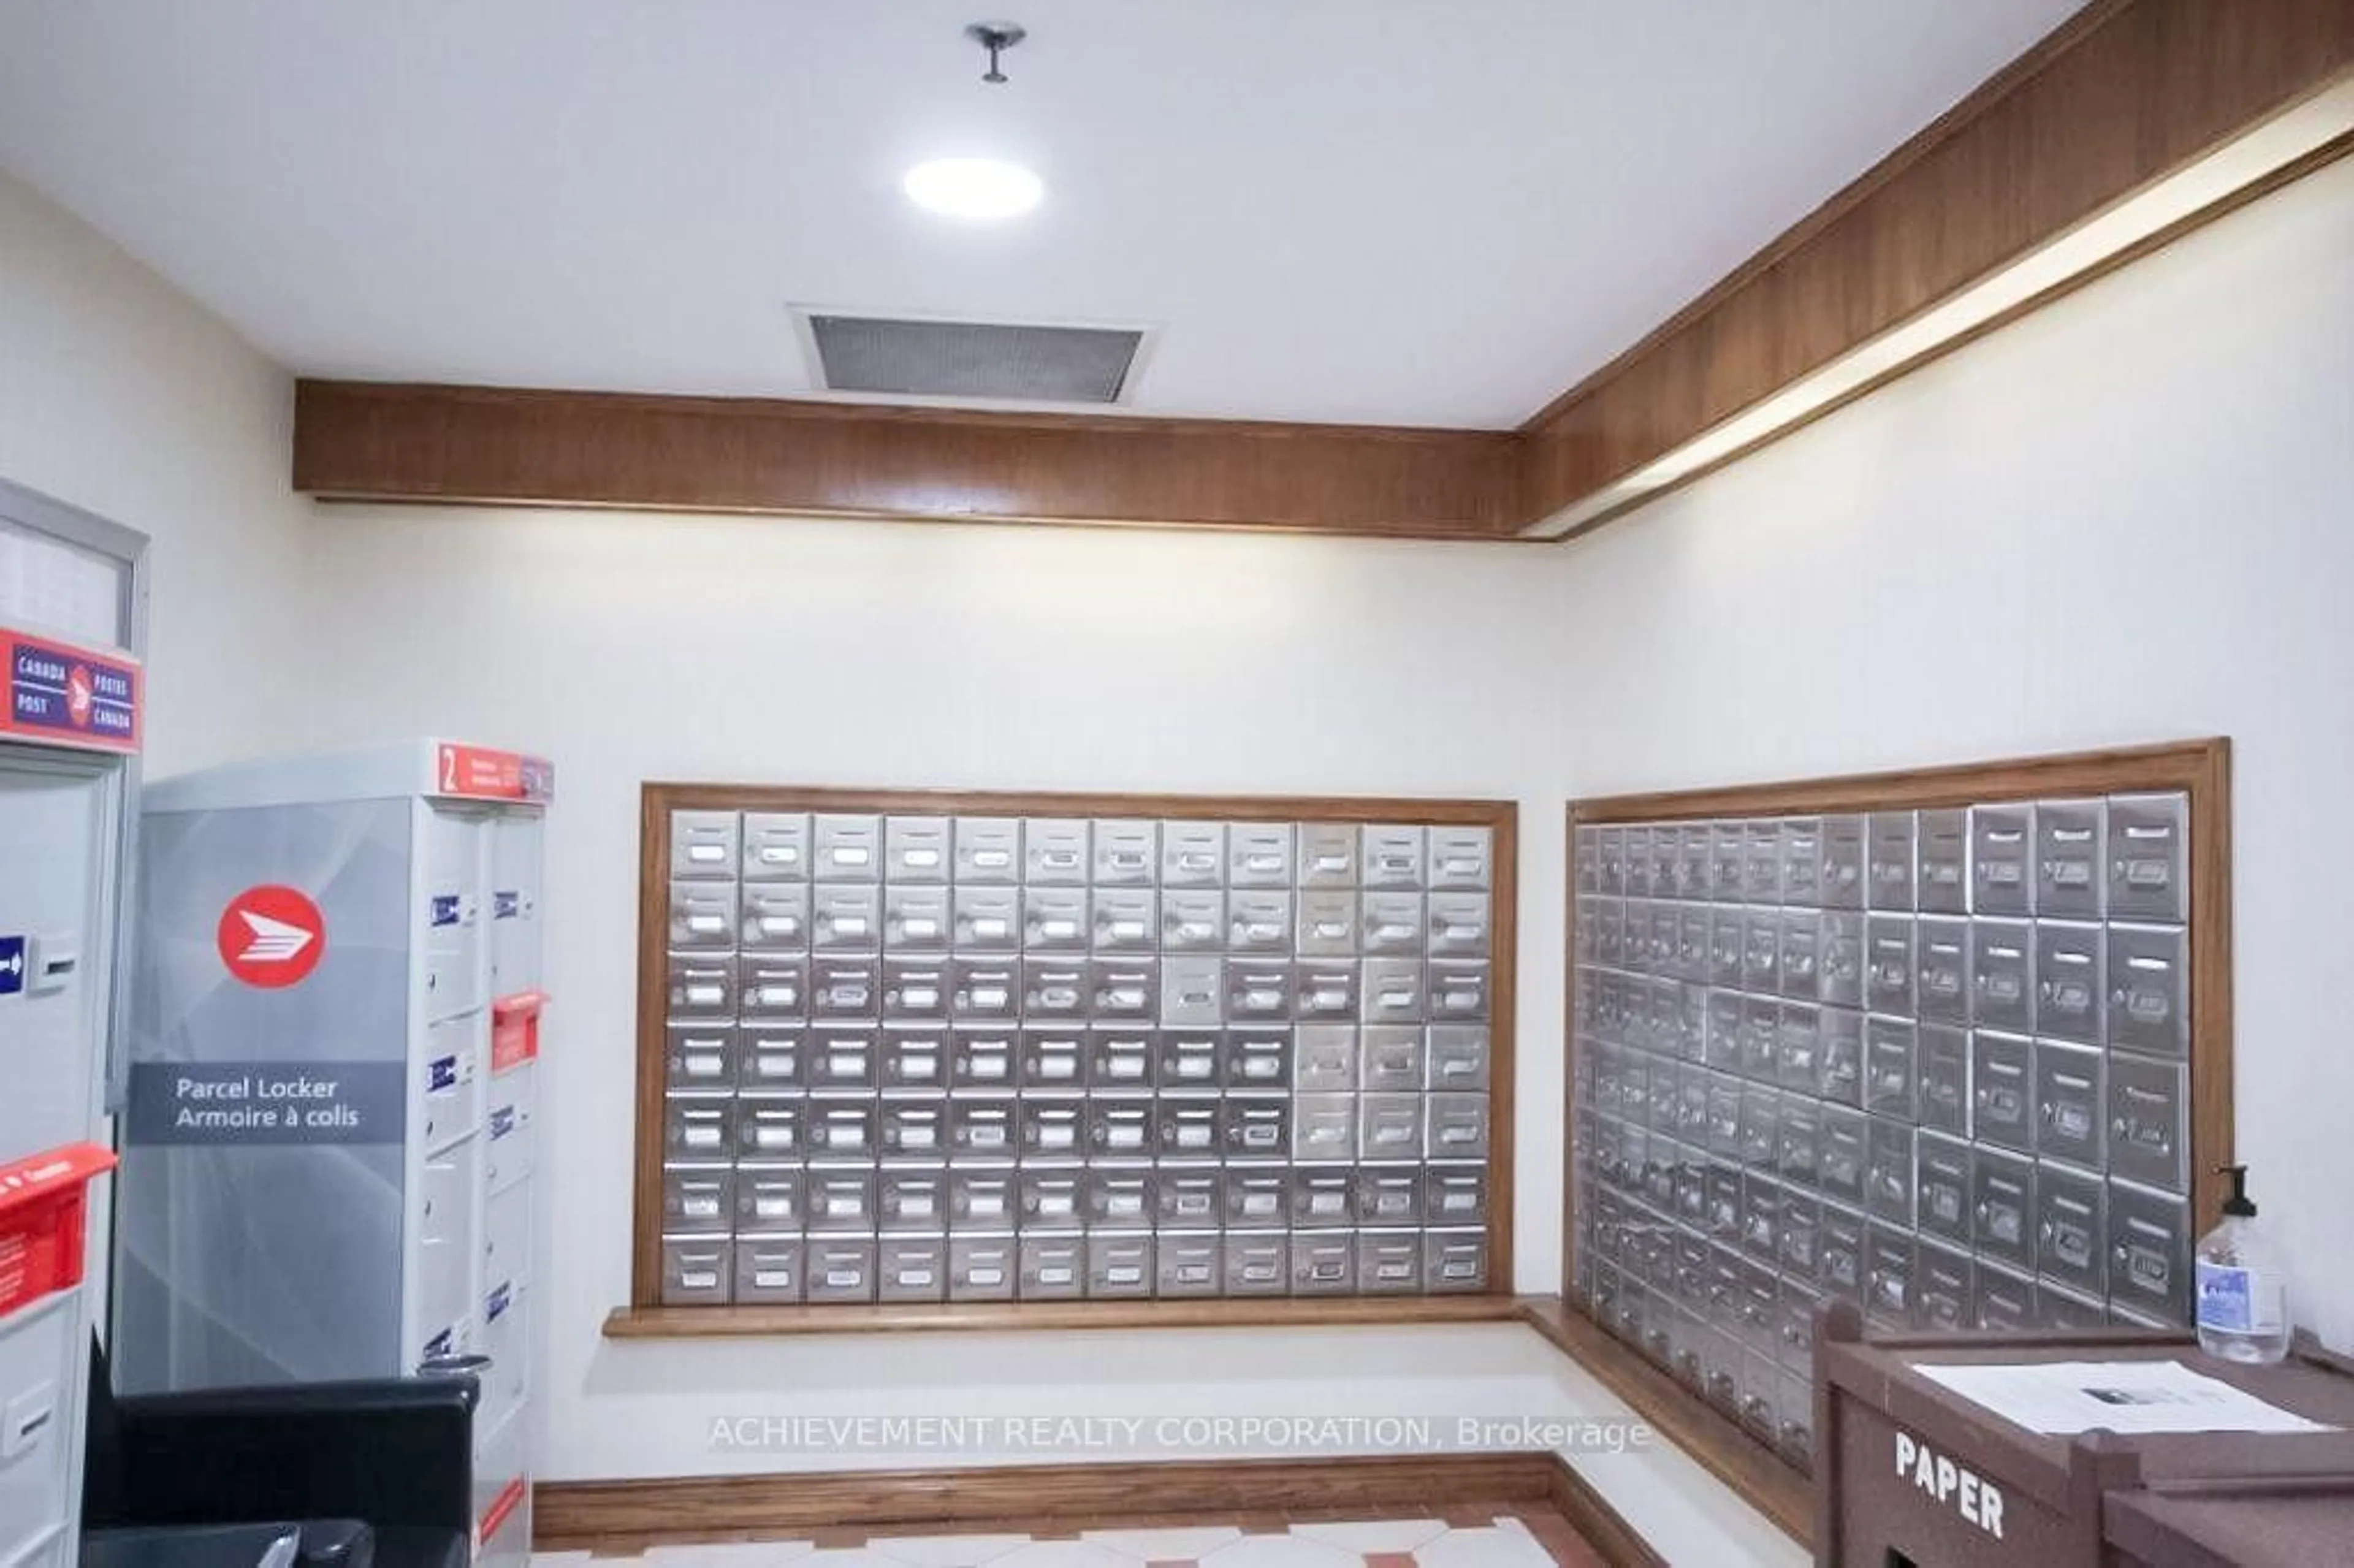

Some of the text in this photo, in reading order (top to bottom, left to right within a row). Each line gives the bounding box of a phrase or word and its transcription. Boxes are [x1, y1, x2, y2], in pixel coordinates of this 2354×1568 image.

[18, 657, 66, 682] CANADA
[18, 693, 48, 714] POST
[443, 747, 459, 792] 2
[176, 1077, 338, 1099] Parcel Locker
[176, 1105, 359, 1128] Armoire à colis
[1895, 1431, 2004, 1539] PAPER
